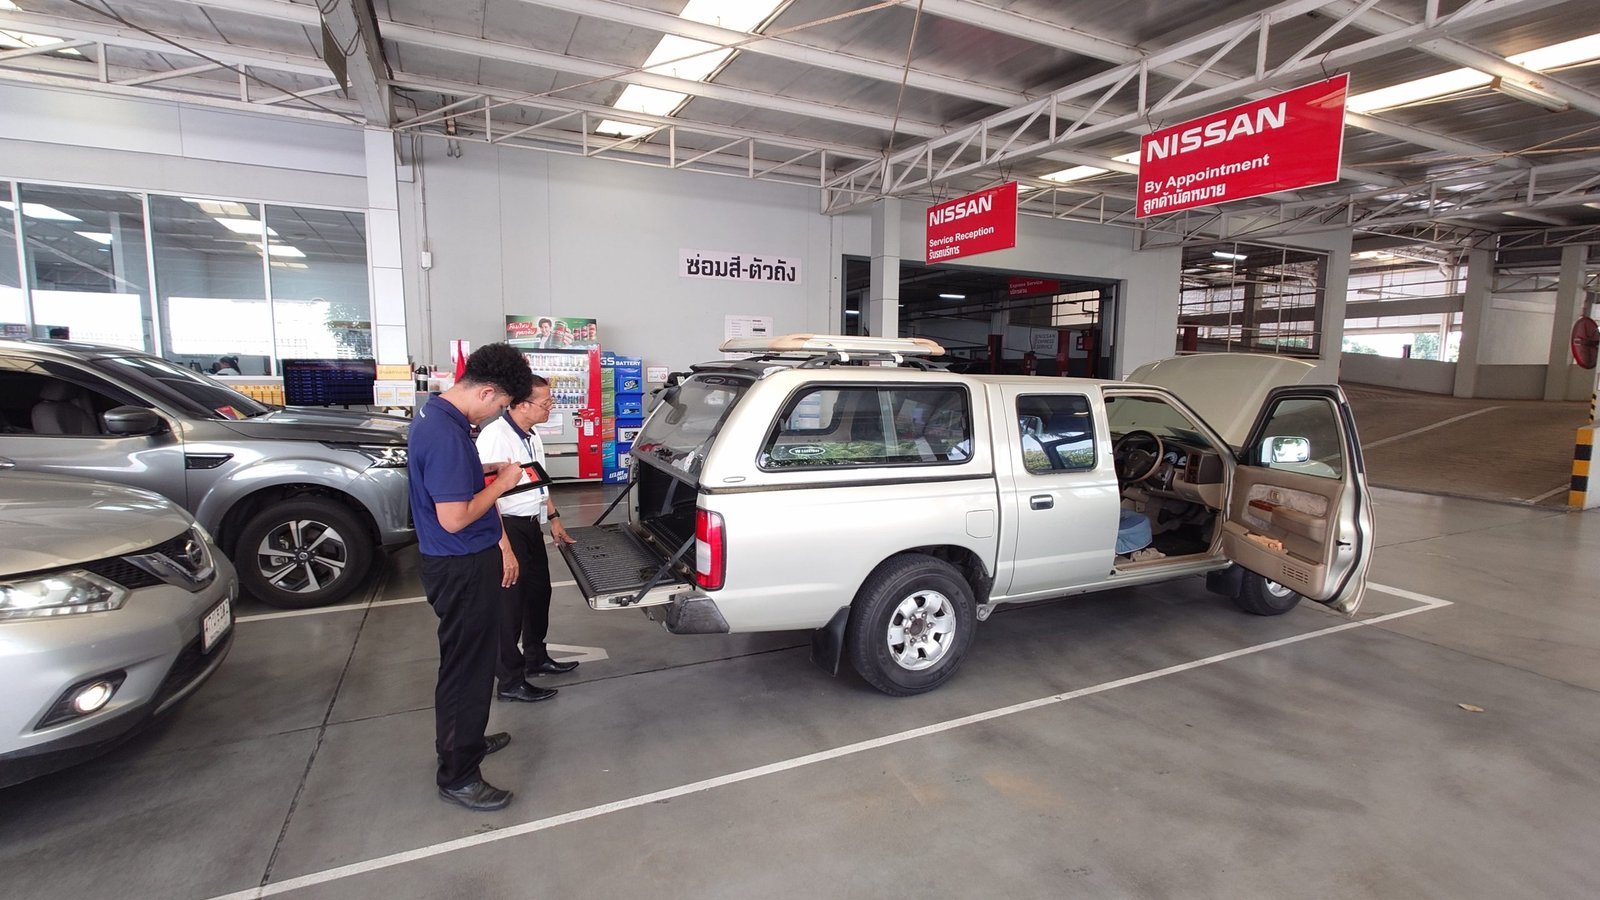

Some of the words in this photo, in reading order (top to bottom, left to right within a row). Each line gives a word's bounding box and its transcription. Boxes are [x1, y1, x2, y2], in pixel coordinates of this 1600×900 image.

[1146, 102, 1287, 162] NISSAN
[1144, 180, 1163, 194] By
[1165, 153, 1270, 188] Appointment
[929, 194, 992, 227] NISSAN
[1143, 183, 1226, 215] ลูกค้านัดหมาย
[929, 234, 954, 248] Service
[955, 226, 994, 242] Reception
[686, 254, 796, 282] ซ่อมสี-ตัวถัง
[600, 357, 615, 366] GS
